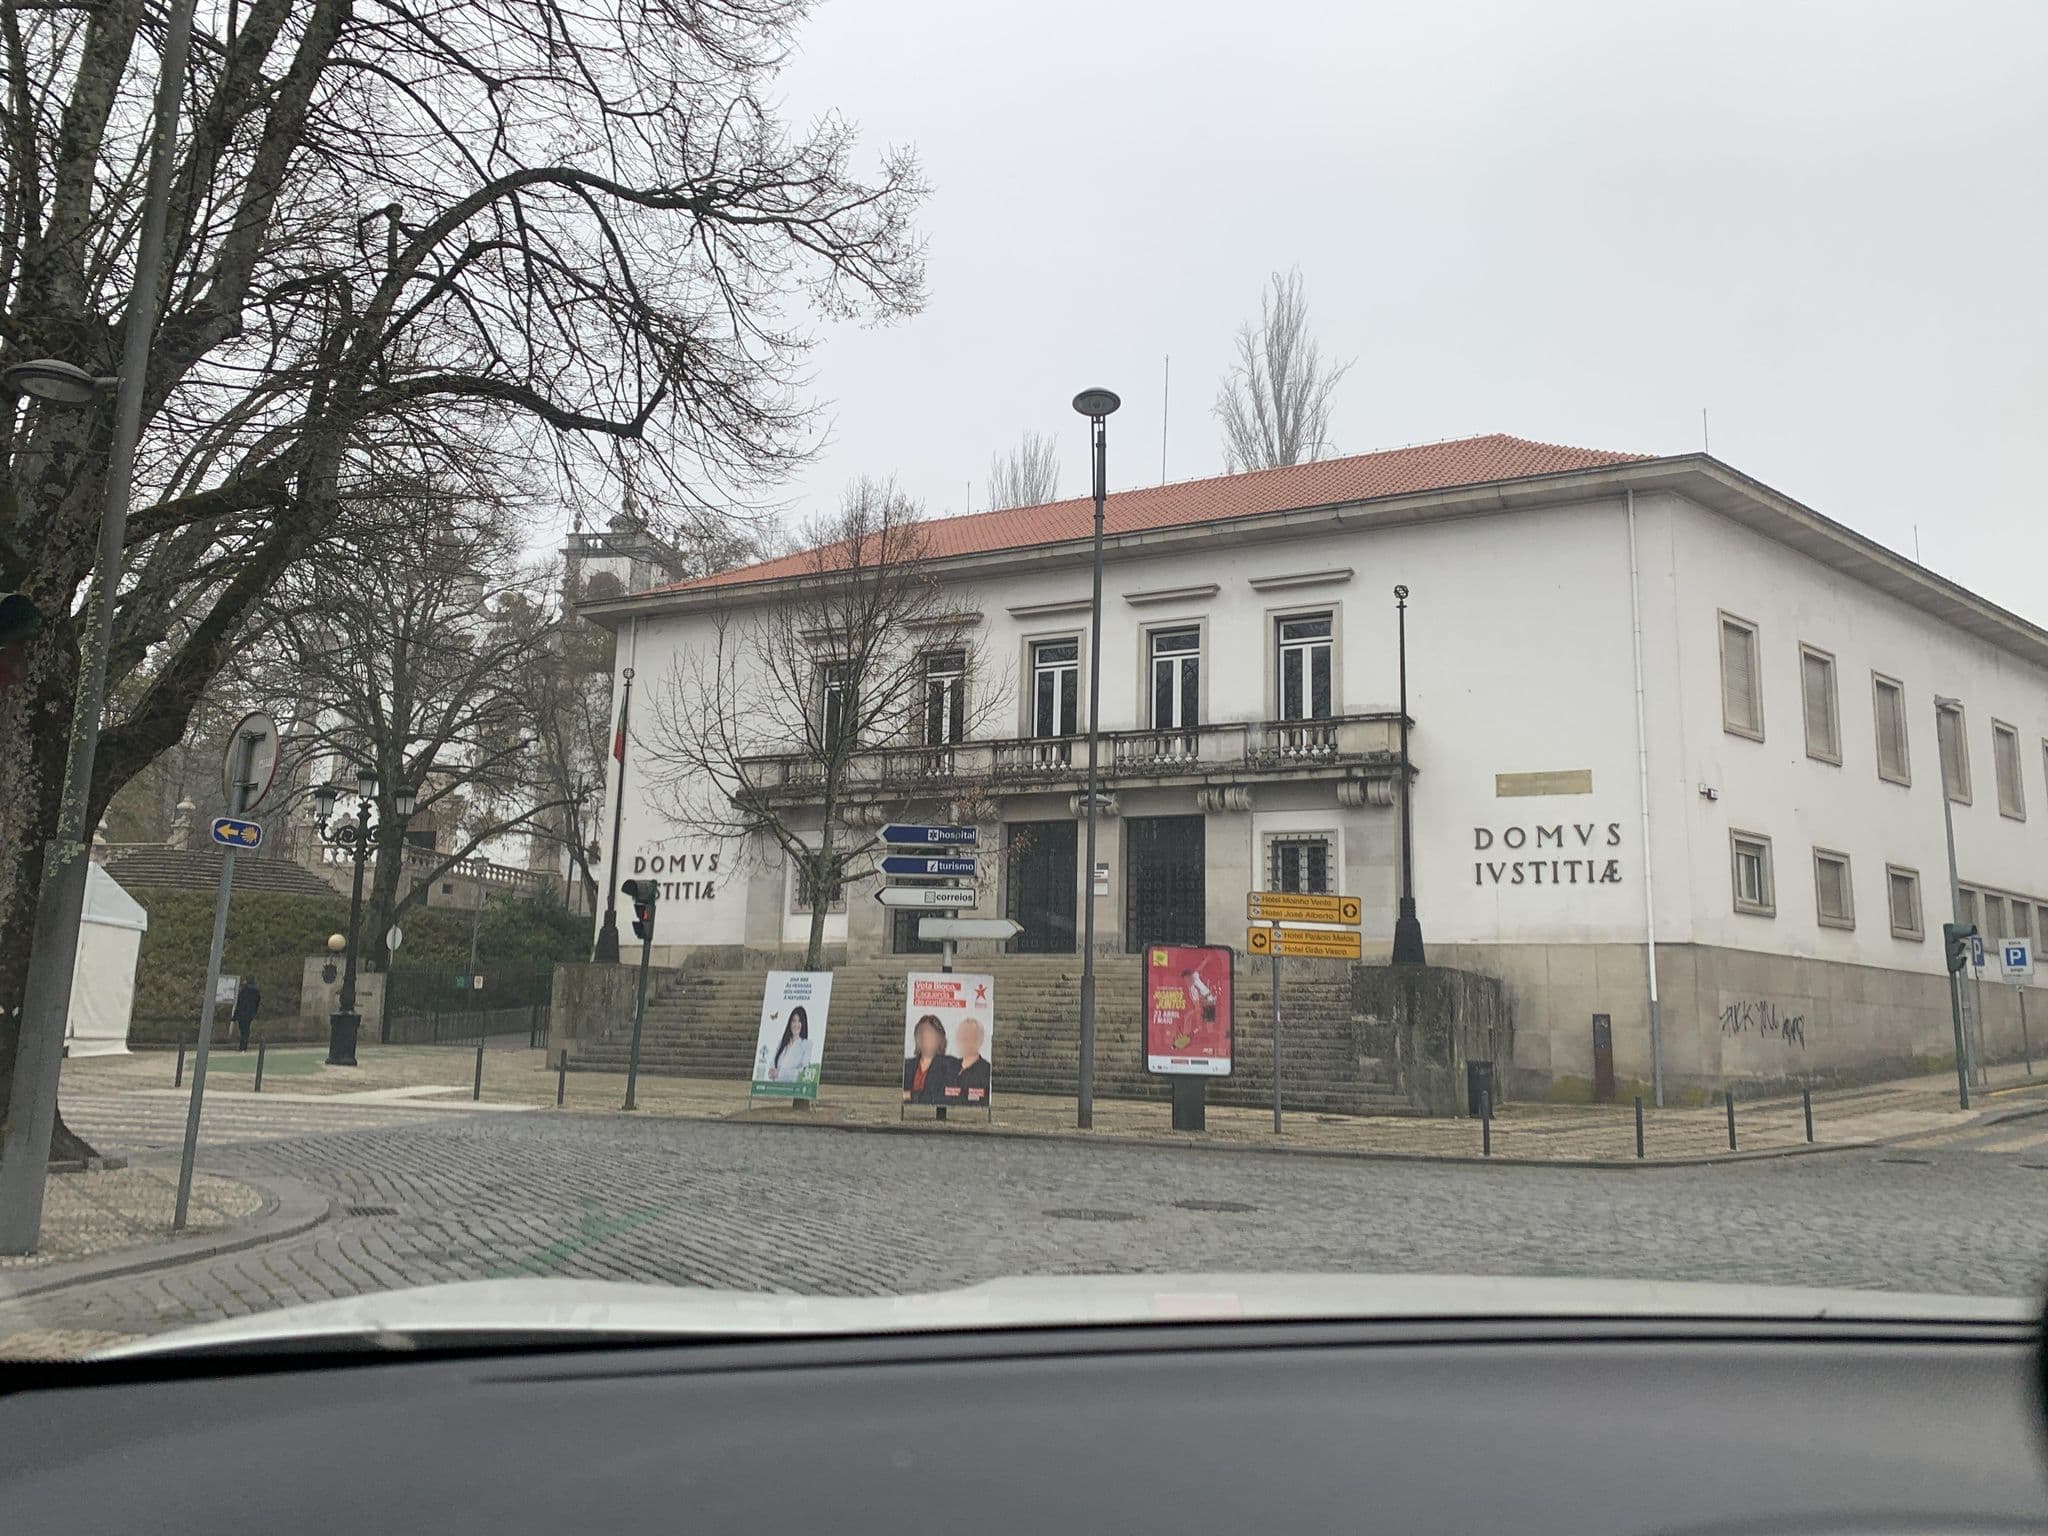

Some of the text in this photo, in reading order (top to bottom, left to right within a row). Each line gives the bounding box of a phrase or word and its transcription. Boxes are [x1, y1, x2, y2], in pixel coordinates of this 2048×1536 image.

[939, 829, 975, 842] hospital
[1473, 822, 1621, 850] DOMVS
[633, 853, 720, 874] DOMVS
[939, 862, 974, 871] turismo
[1474, 859, 1622, 886] IVSTITIÆ
[936, 892, 973, 902] correios
[1261, 895, 1281, 903] Hotel
[1261, 909, 1334, 920] Hotel José Alberto
[1284, 932, 1304, 940] Hotel
[1284, 945, 1304, 953] Hotel
[1973, 940, 1982, 962] P
[2009, 949, 2022, 965] P
